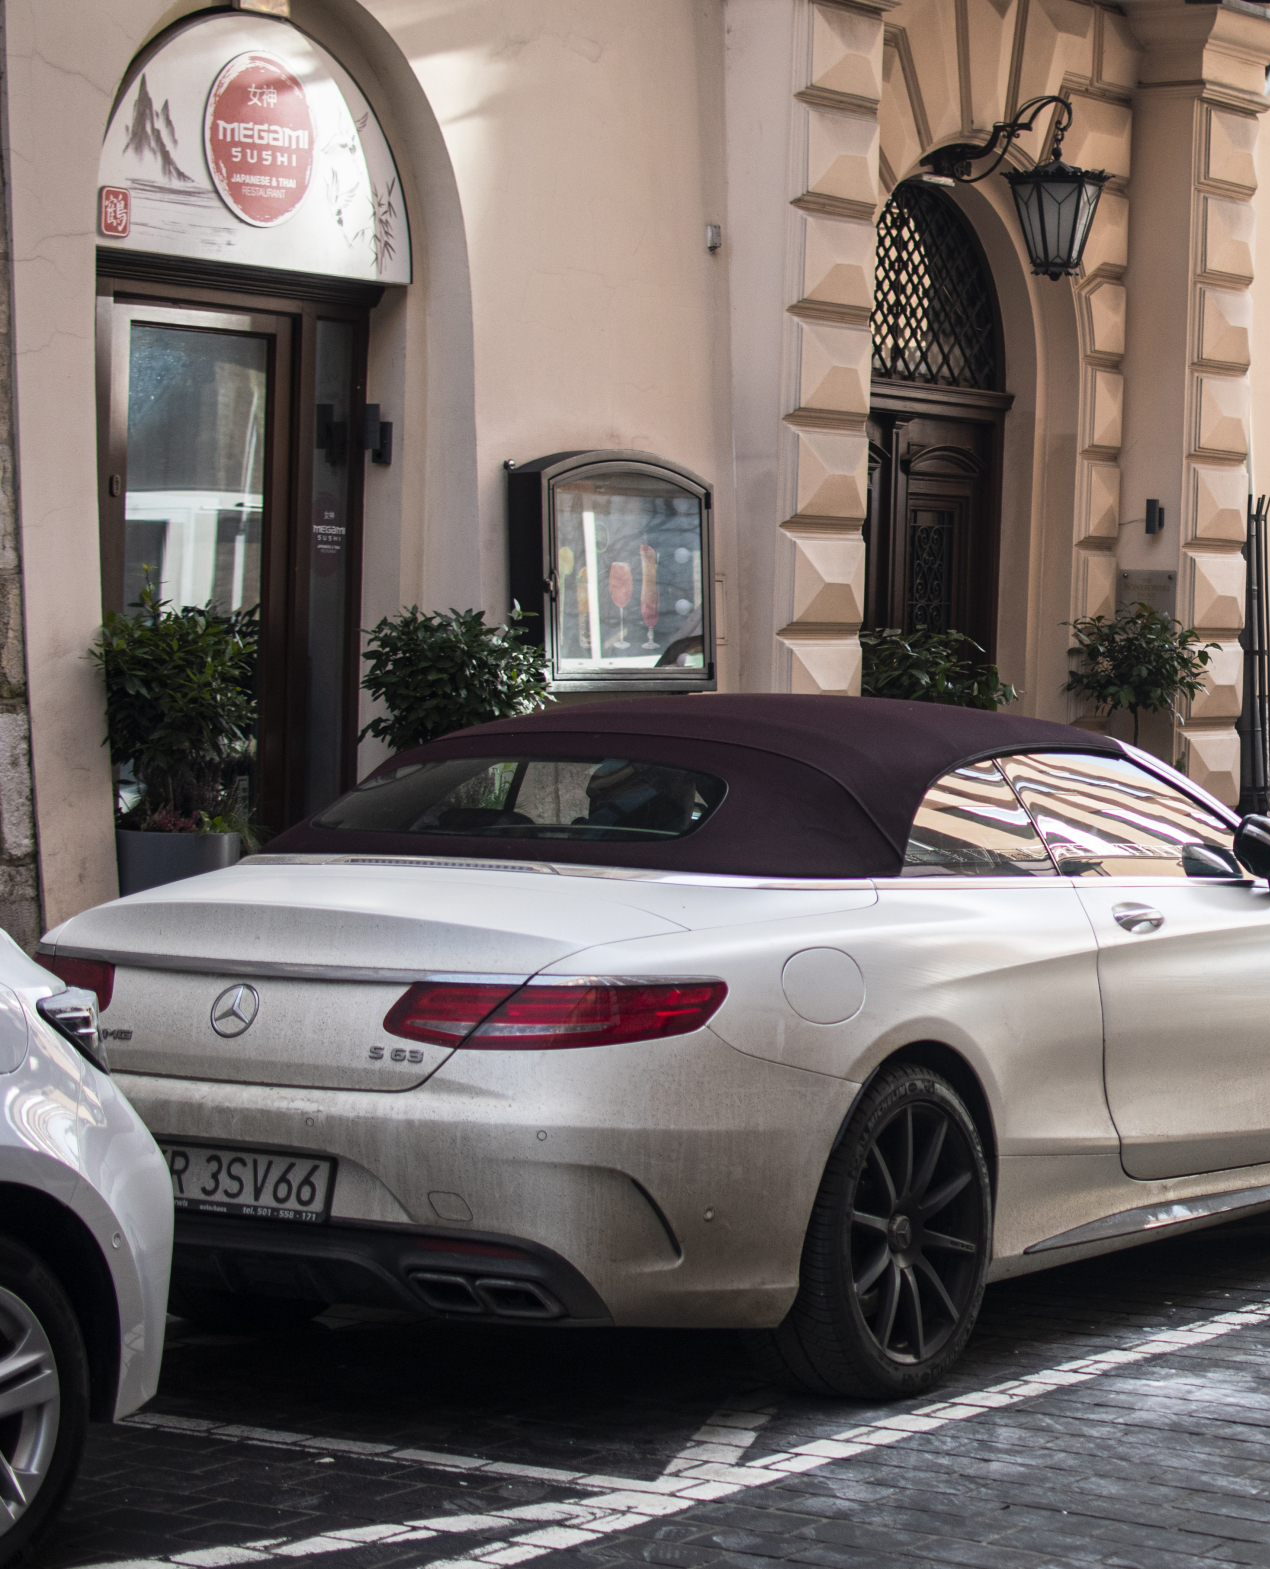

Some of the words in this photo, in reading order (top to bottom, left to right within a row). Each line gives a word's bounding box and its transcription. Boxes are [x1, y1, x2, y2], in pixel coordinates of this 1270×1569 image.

[247, 83, 278, 108] 女神
[232, 147, 297, 167] SUSHI
[231, 173, 270, 186] JAPANESE
[271, 177, 278, 187] &
[279, 178, 297, 188] THAI
[242, 186, 286, 199] RESTAURANT
[102, 1028, 133, 1040] MG
[369, 1045, 385, 1061] S
[391, 1047, 424, 1063] 63
[200, 1154, 320, 1207] 3SV66
[243, 1206, 255, 1215] tel.
[257, 1207, 272, 1216] 501
[279, 1209, 295, 1219] 558
[302, 1212, 317, 1221] 171
